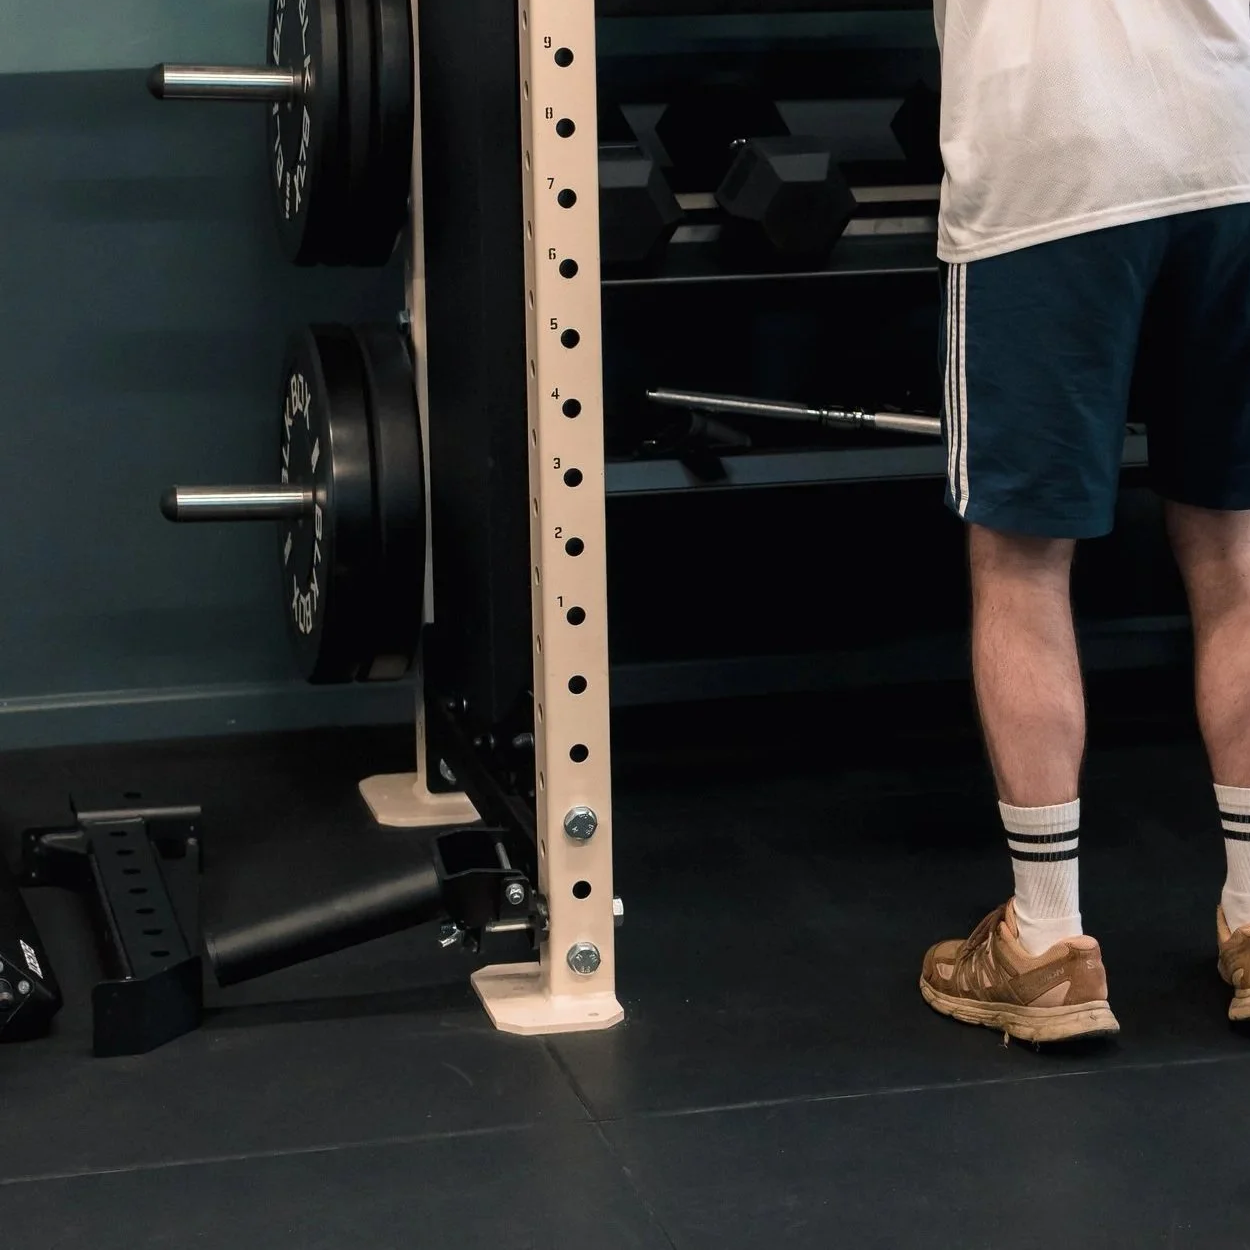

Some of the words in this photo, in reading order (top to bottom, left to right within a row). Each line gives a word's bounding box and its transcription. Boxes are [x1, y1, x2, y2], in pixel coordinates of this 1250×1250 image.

[544, 36, 551, 48] 9
[546, 107, 553, 119] 8
[547, 178, 554, 189] 7
[549, 248, 556, 260] 6
[550, 318, 558, 330] 5
[551, 388, 560, 399] 4
[554, 458, 560, 469] 3
[555, 527, 562, 538] 2
[557, 596, 562, 607] 1
